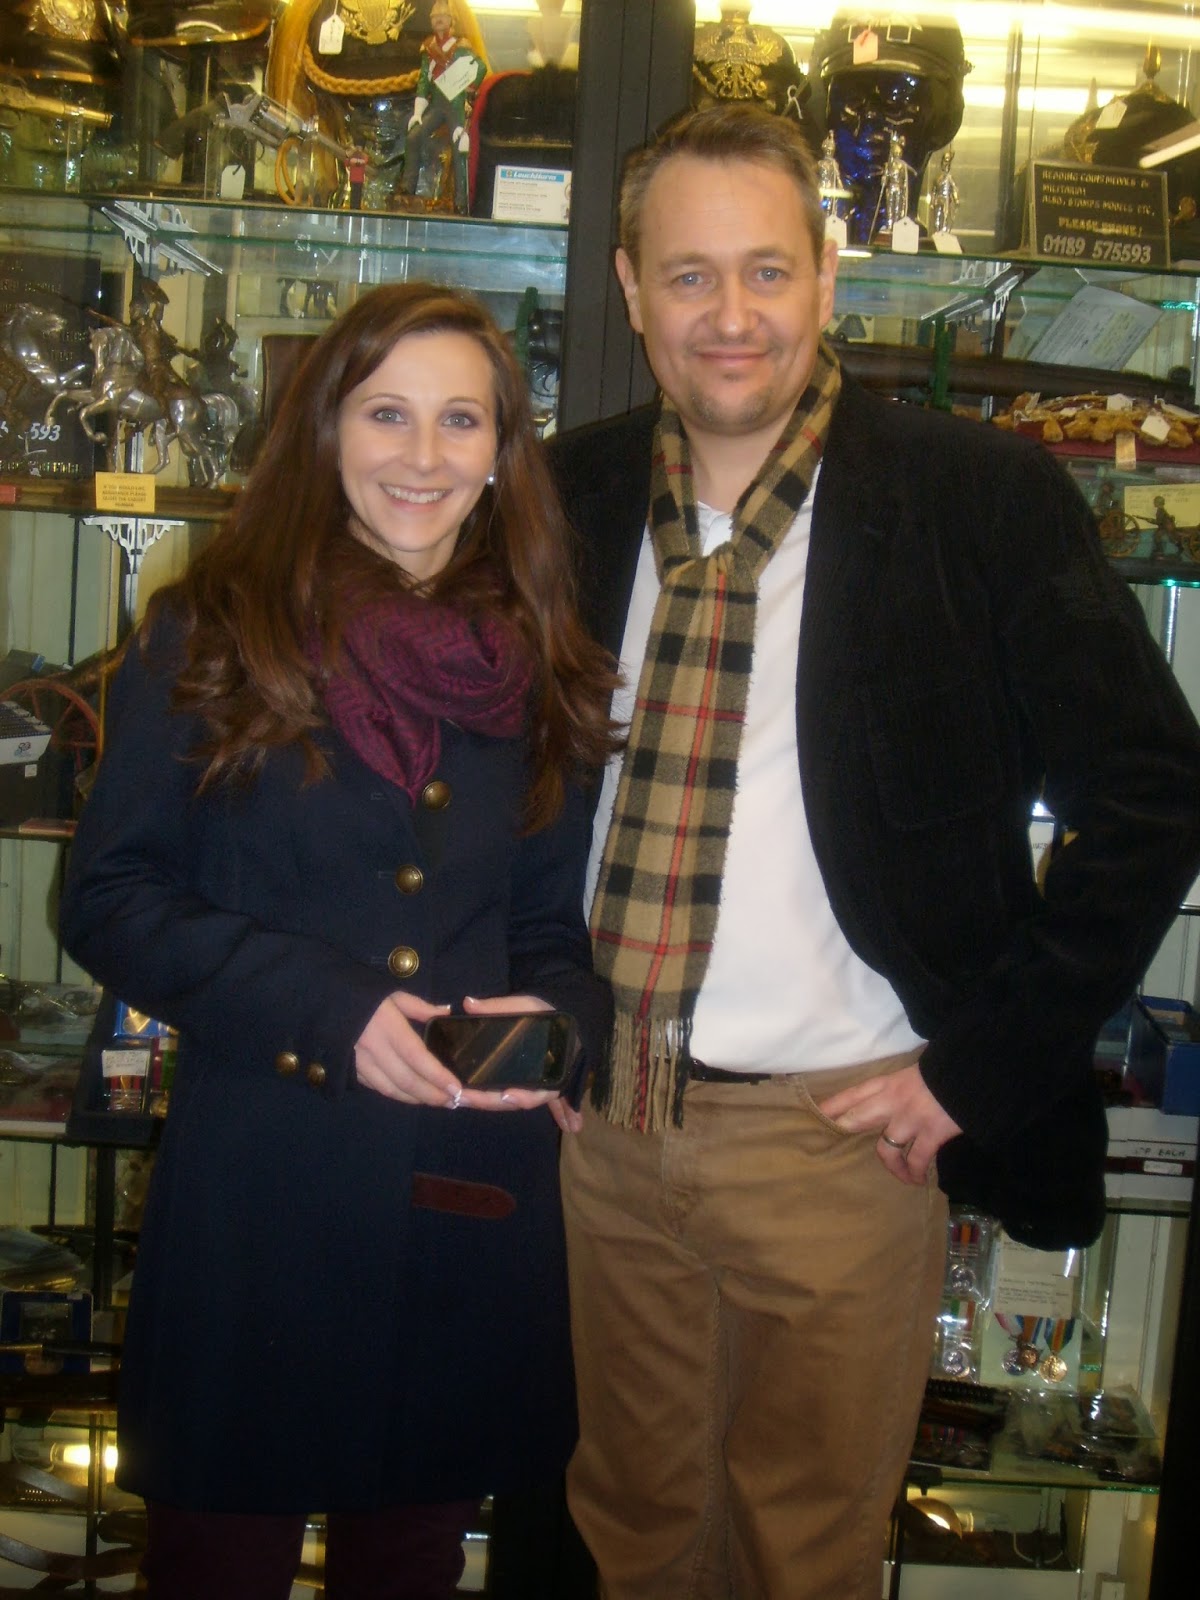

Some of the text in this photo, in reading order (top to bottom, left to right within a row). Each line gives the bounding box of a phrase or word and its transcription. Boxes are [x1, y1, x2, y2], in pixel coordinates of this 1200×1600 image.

[1043, 233, 1152, 264] 01189 575593
[30, 422, 62, 442] 593
